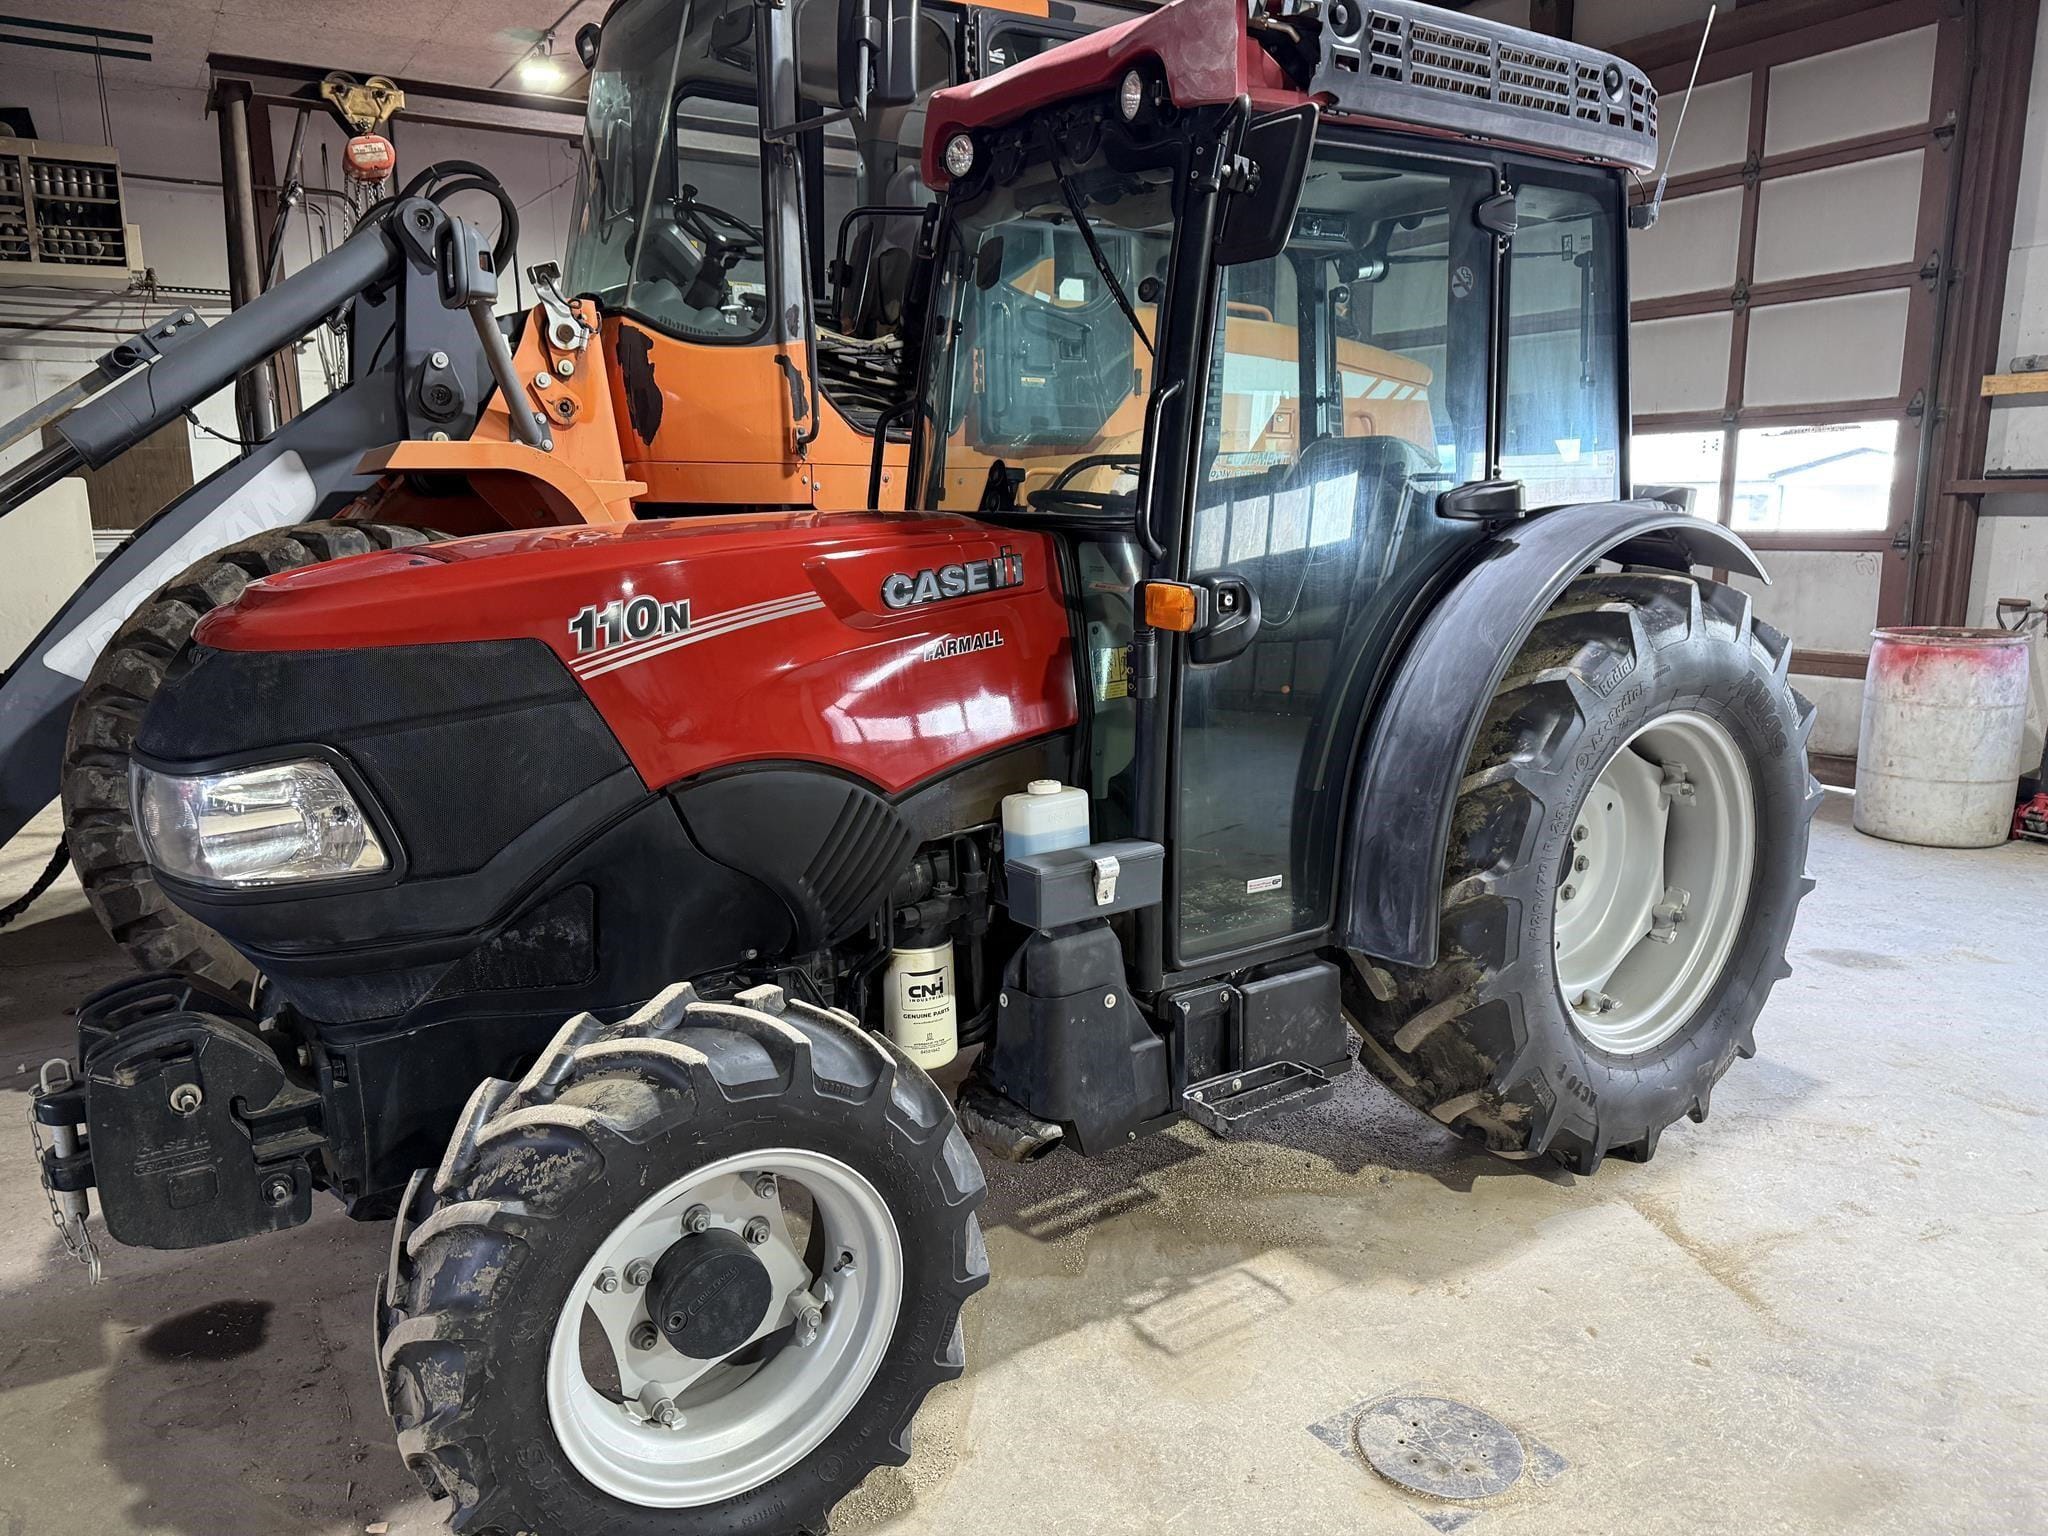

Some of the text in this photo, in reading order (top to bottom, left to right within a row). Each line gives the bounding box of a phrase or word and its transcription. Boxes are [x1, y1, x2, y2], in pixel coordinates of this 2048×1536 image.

[881, 559, 990, 610] CASE
[568, 594, 692, 655] 110N
[923, 629, 1004, 663] FARMALL
[933, 1007, 950, 1017] PARTS
